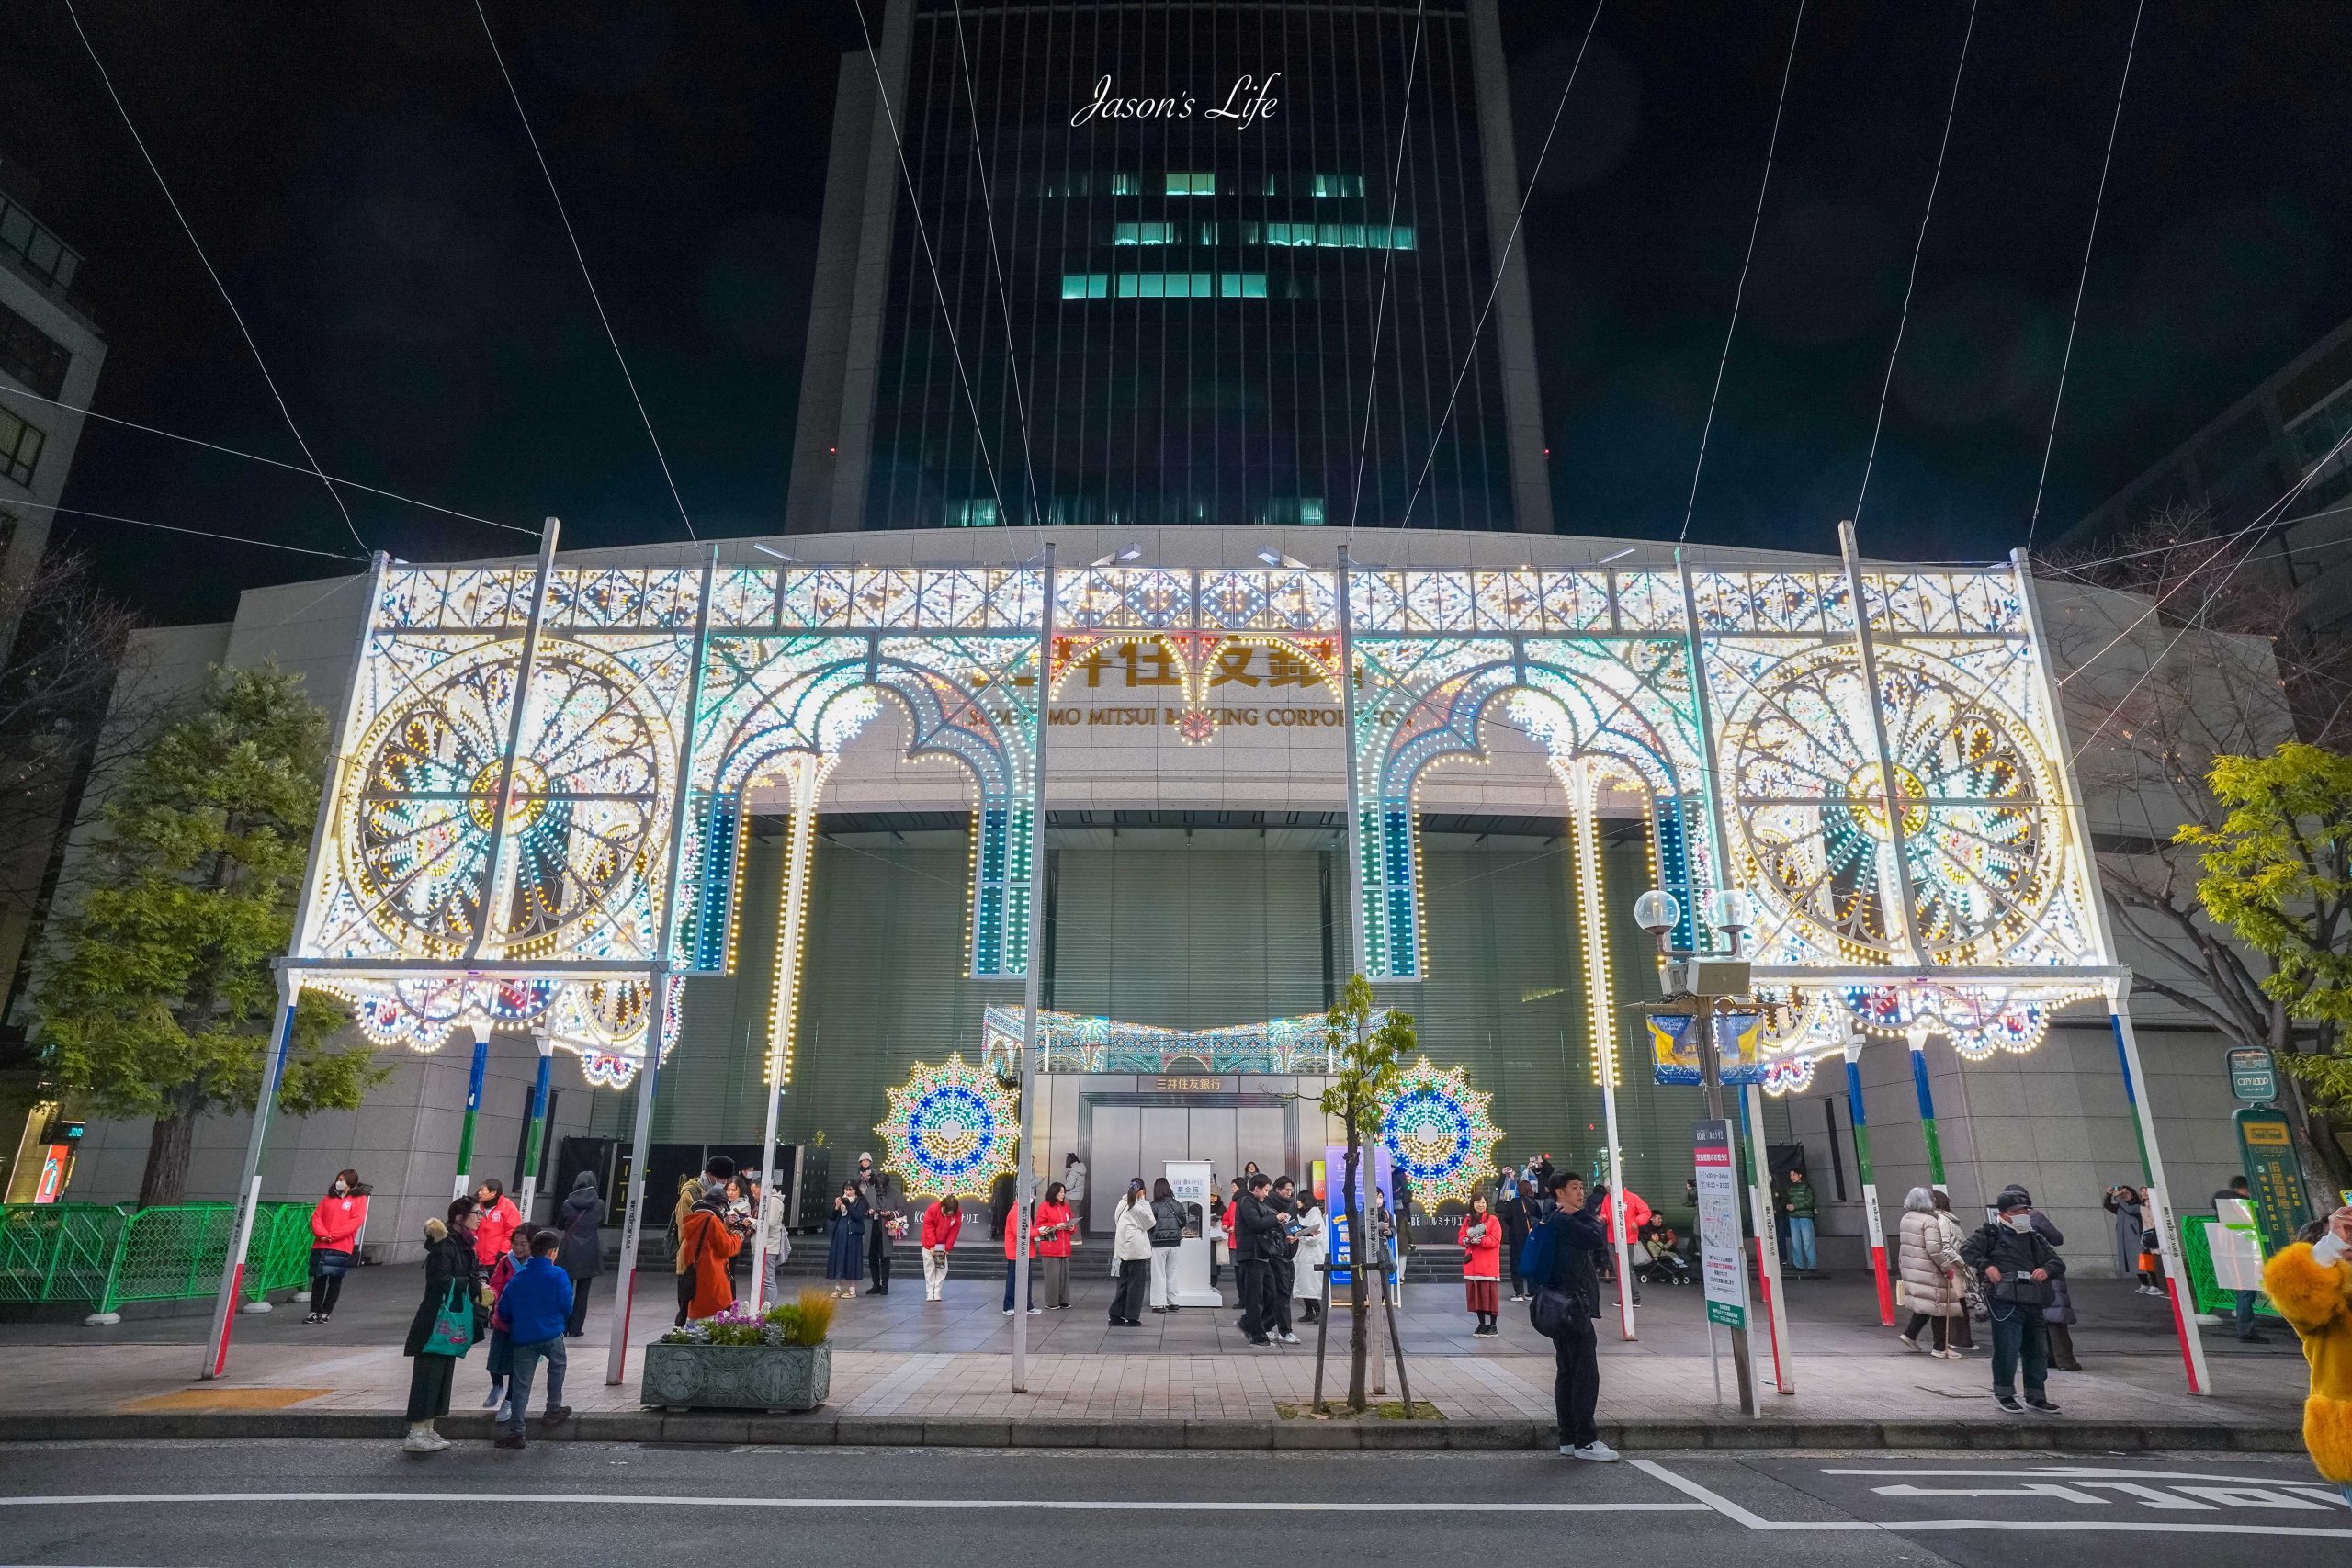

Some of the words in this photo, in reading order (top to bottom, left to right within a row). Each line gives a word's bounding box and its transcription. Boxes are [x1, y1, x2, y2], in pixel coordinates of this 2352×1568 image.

[1087, 707, 1158, 726] MITSUI
[1157, 1077, 1221, 1089] 三井住友銀行
[2257, 1165, 2265, 1173] 5
